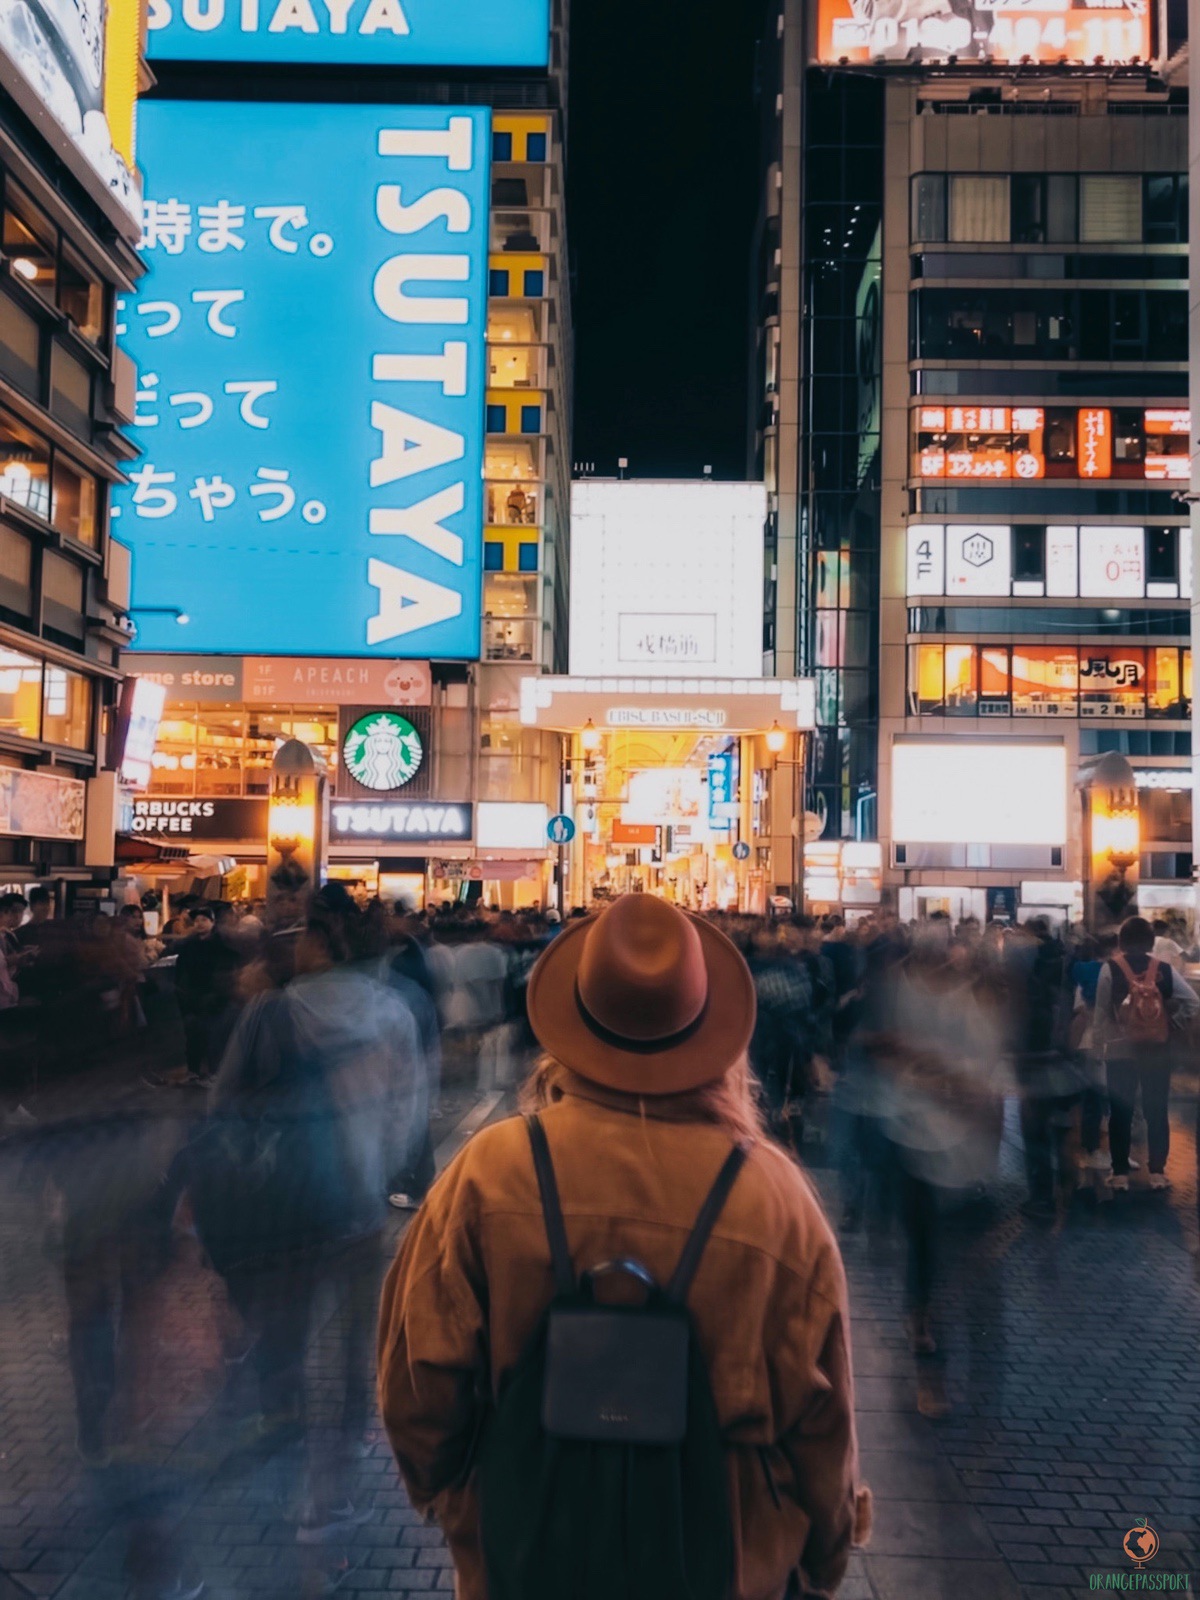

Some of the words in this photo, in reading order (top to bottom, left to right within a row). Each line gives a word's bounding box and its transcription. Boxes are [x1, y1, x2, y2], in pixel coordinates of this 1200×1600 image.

[135, 198, 334, 257] 時まで。
[366, 116, 473, 646] TSUTAYA
[110, 464, 327, 524] ちゃう。
[127, 672, 174, 685] me
[181, 670, 236, 686] store
[293, 667, 369, 684] APEACH
[1080, 656, 1139, 687] 風月
[132, 801, 215, 817] RBUCKS
[332, 806, 465, 833] TSUTAYA
